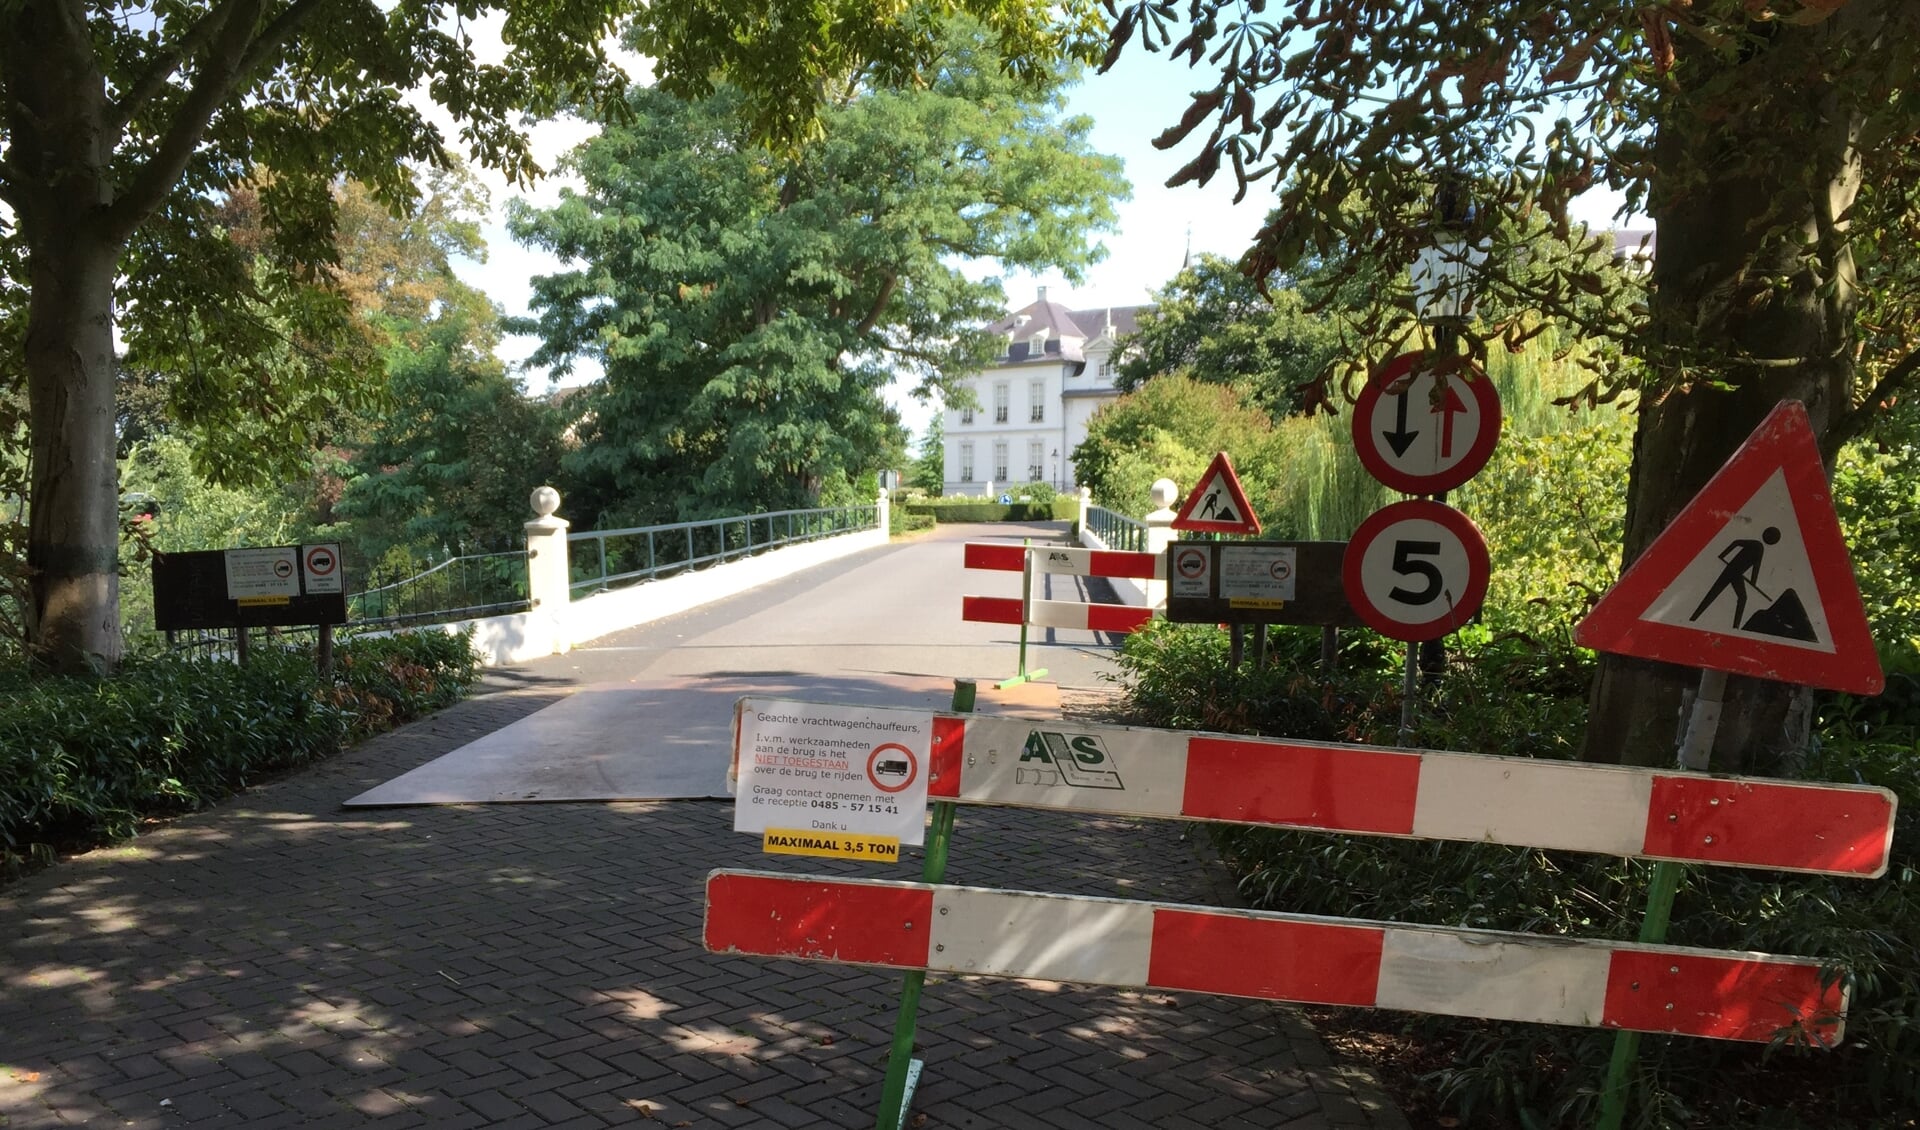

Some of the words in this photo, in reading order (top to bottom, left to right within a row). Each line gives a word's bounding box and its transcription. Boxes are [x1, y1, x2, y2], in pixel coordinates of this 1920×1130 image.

[1388, 540, 1444, 606] 5
[757, 712, 799, 725] Geachte
[801, 717, 921, 734] vrachtwagenchauffeurs,
[756, 733, 785, 744] I.v.m.
[789, 736, 871, 750] werkzaamheden
[755, 745, 774, 753] aan
[777, 745, 789, 754] de
[792, 747, 816, 758] brug
[819, 748, 827, 757] is
[830, 749, 847, 759] het
[754, 753, 778, 764] NIET
[782, 755, 849, 770] TOEGESTAAN
[754, 766, 776, 775] over
[779, 766, 792, 776] de
[794, 768, 817, 780] brug
[820, 769, 831, 779] te
[834, 770, 863, 782] rijden
[752, 785, 783, 797] Graag
[786, 787, 822, 799] contact
[825, 791, 872, 803] opnemen
[875, 794, 895, 804] met
[752, 795, 765, 805] de
[767, 796, 808, 808] receptie
[810, 799, 839, 810] 0485
[850, 803, 864, 812] 57
[868, 804, 882, 813] 15
[885, 805, 899, 815] 41
[811, 819, 838, 831] Dank
[840, 823, 847, 831] u
[768, 835, 840, 851] MAXIMAAL
[844, 841, 864, 853] 3,5
[868, 843, 896, 855] TON
